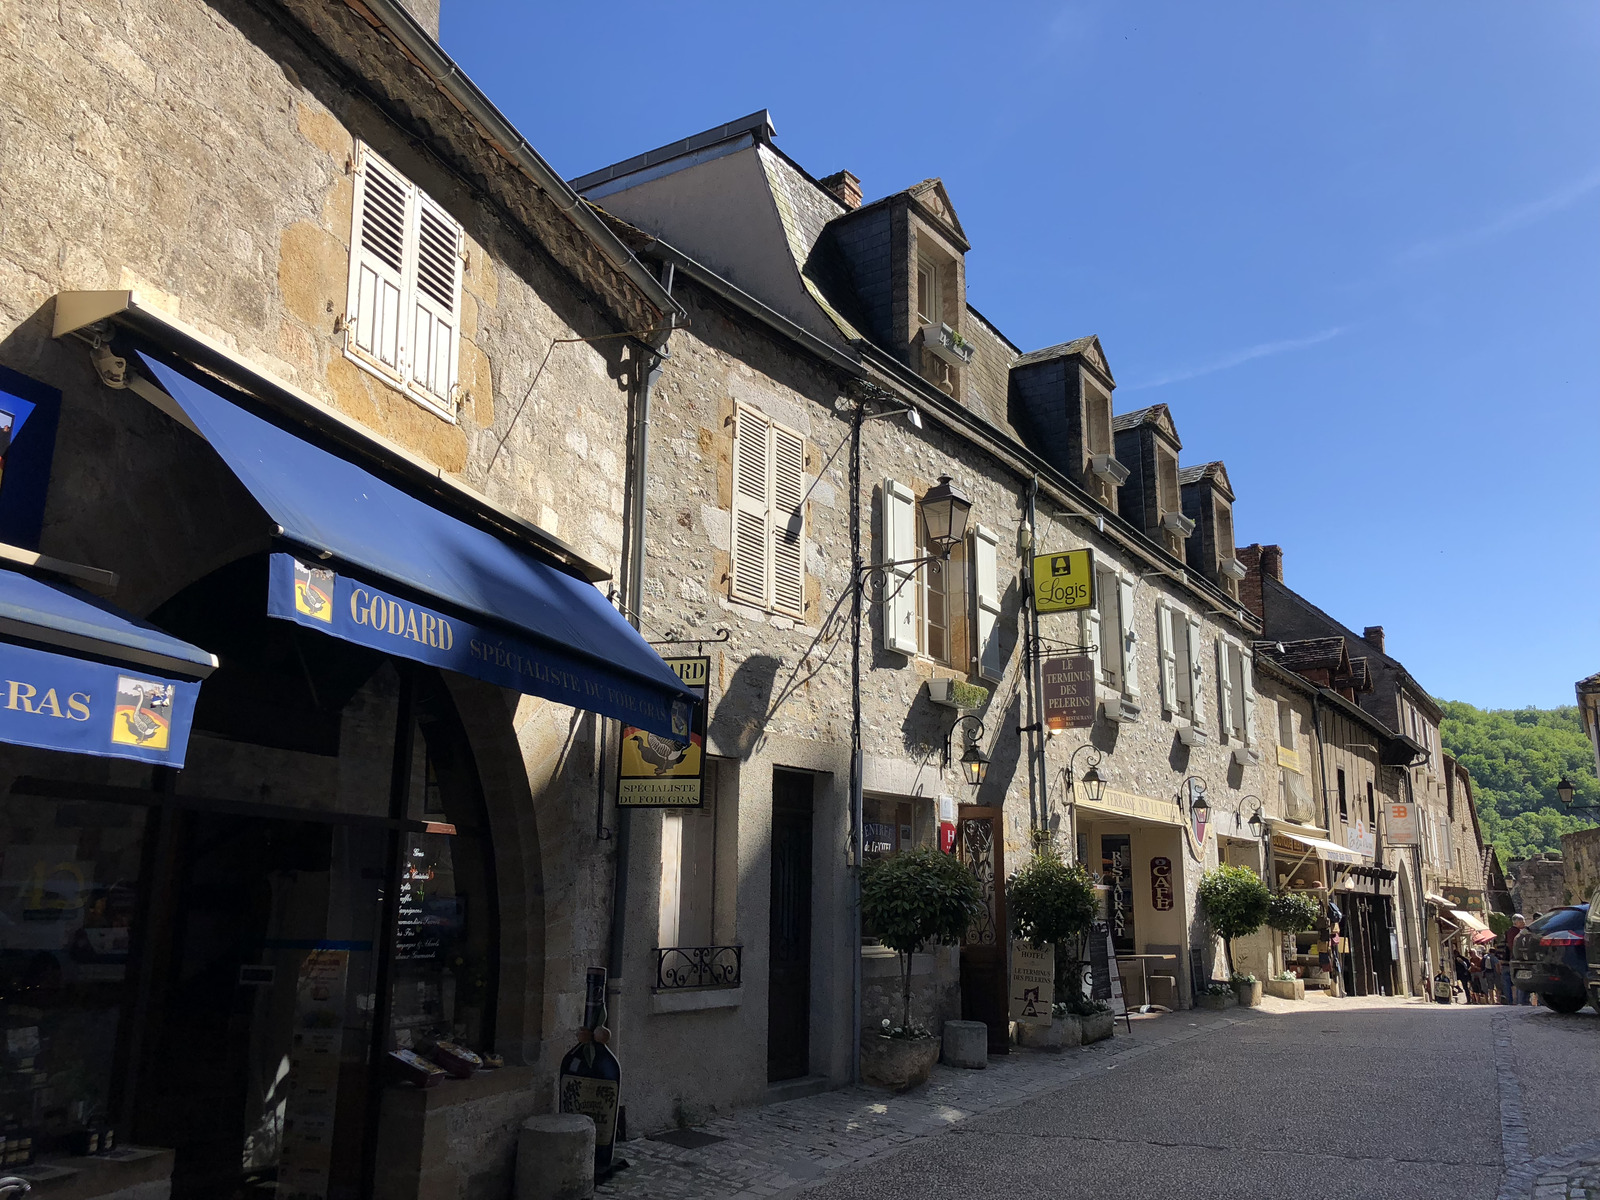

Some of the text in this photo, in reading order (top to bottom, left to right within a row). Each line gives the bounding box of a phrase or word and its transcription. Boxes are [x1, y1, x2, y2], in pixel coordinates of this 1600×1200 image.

[1038, 578, 1087, 605] Logis
[351, 588, 667, 722] GODARD SPÉCIALISTE DU FOIE GRAS
[1062, 659, 1073, 670] LE
[1046, 671, 1091, 684] TERMINUS
[1060, 684, 1077, 695] DES
[0, 680, 91, 722] RAS
[1049, 696, 1090, 709] PELERINS
[624, 781, 696, 793] SPÉCIALISTE
[620, 795, 699, 804] DU FOIE GRAS
[1112, 851, 1126, 937] RESTAURANT
[1021, 951, 1046, 960] HOTEL
[1023, 968, 1051, 977] TERMINUS
[1025, 975, 1051, 984] PELERINS
